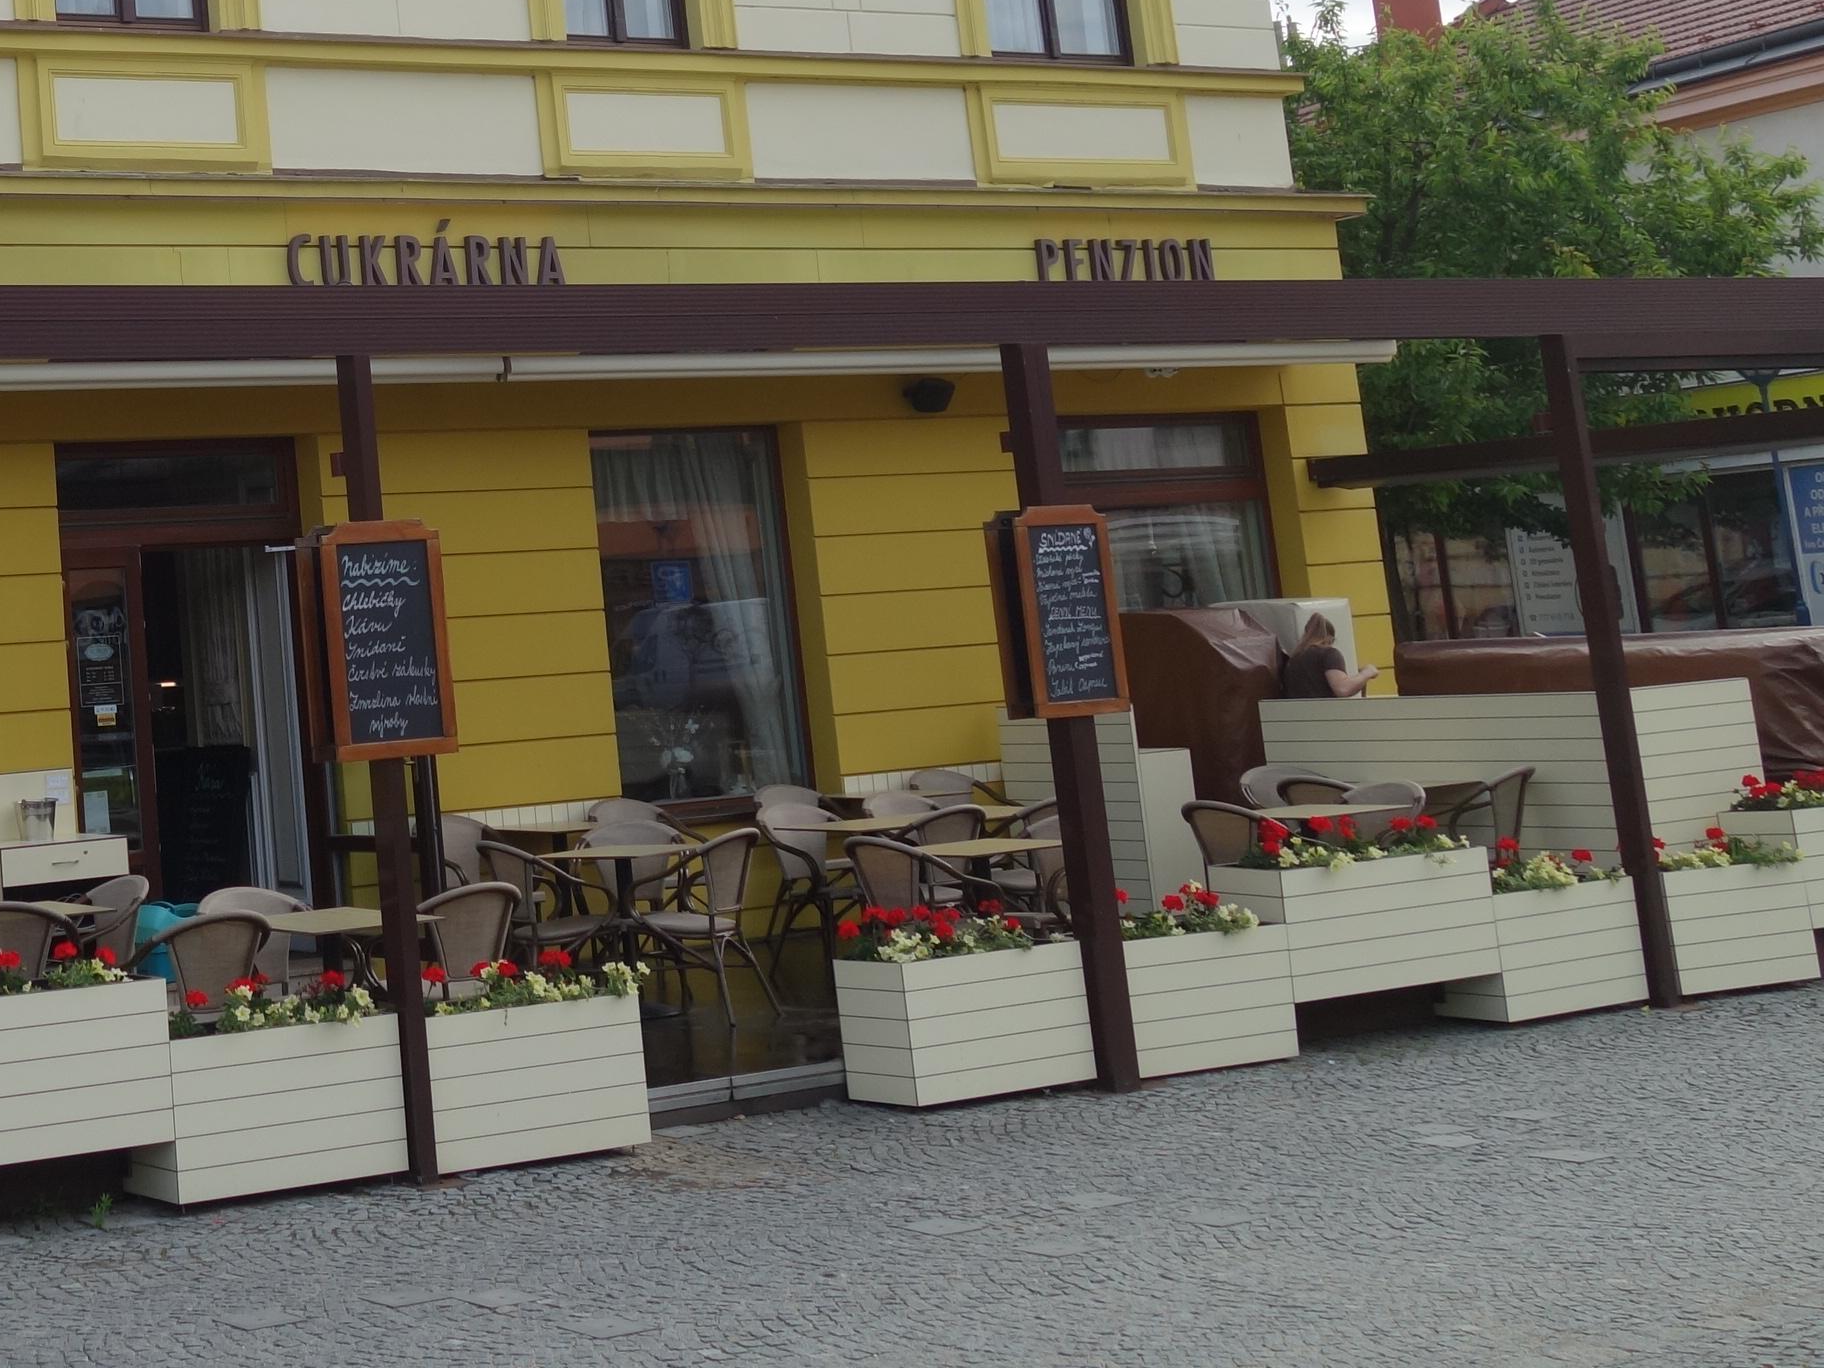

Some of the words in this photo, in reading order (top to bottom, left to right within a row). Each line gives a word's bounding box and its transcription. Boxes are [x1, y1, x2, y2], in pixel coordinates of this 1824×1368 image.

[286, 218, 567, 286] CUKRÁRNA
[1034, 238, 1216, 282] PENZION
[348, 690, 402, 712] Zmrzlina
